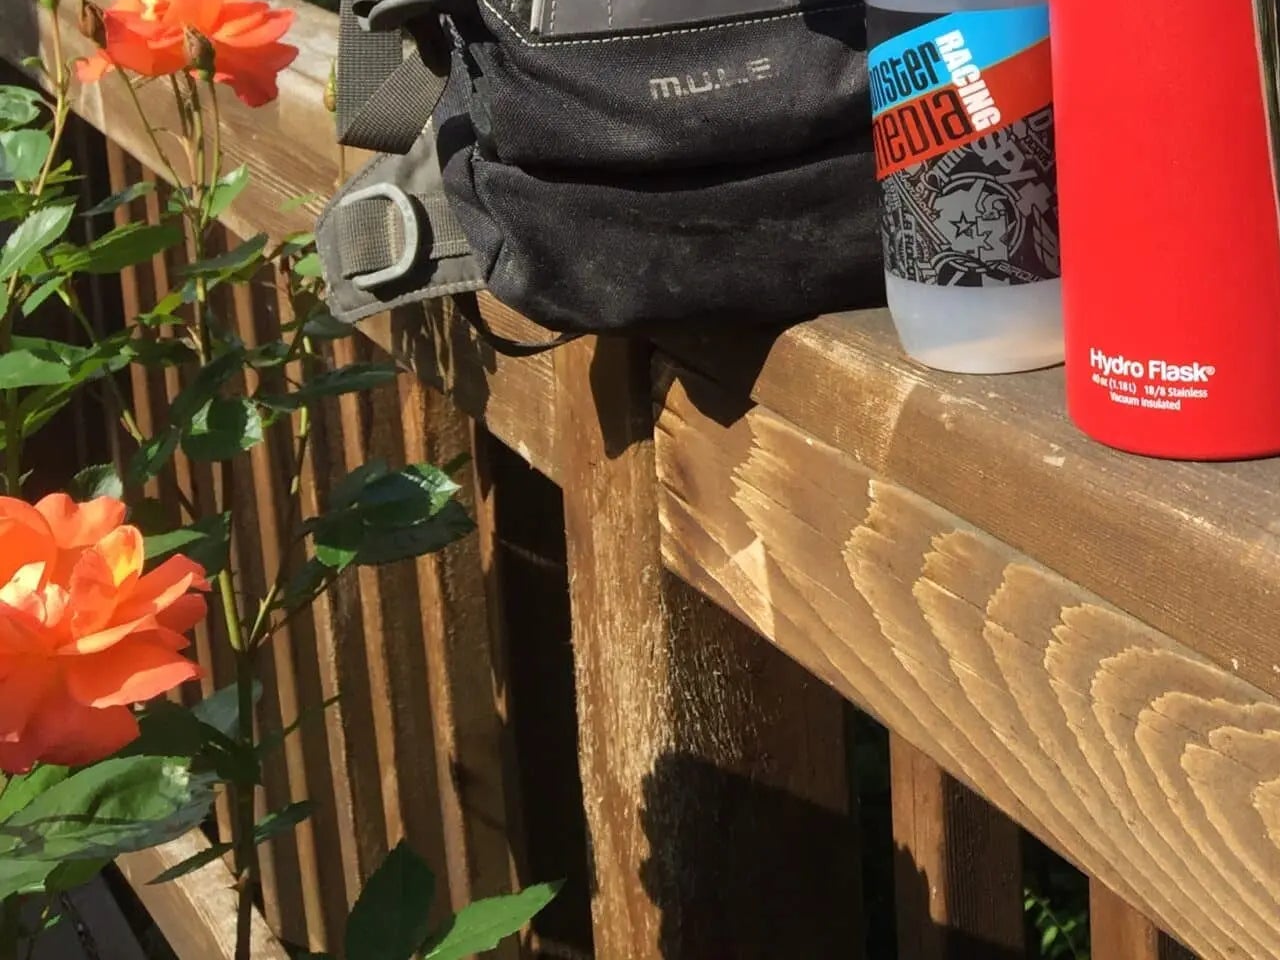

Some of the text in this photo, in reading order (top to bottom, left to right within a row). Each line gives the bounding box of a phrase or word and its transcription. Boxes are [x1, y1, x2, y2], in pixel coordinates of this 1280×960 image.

[935, 30, 1000, 131] RACING
[1090, 347, 1144, 378] Hydro
[1109, 391, 1140, 407] Vacuum
[1144, 384, 1166, 400] 18/8
[1167, 386, 1208, 399] Stainless
